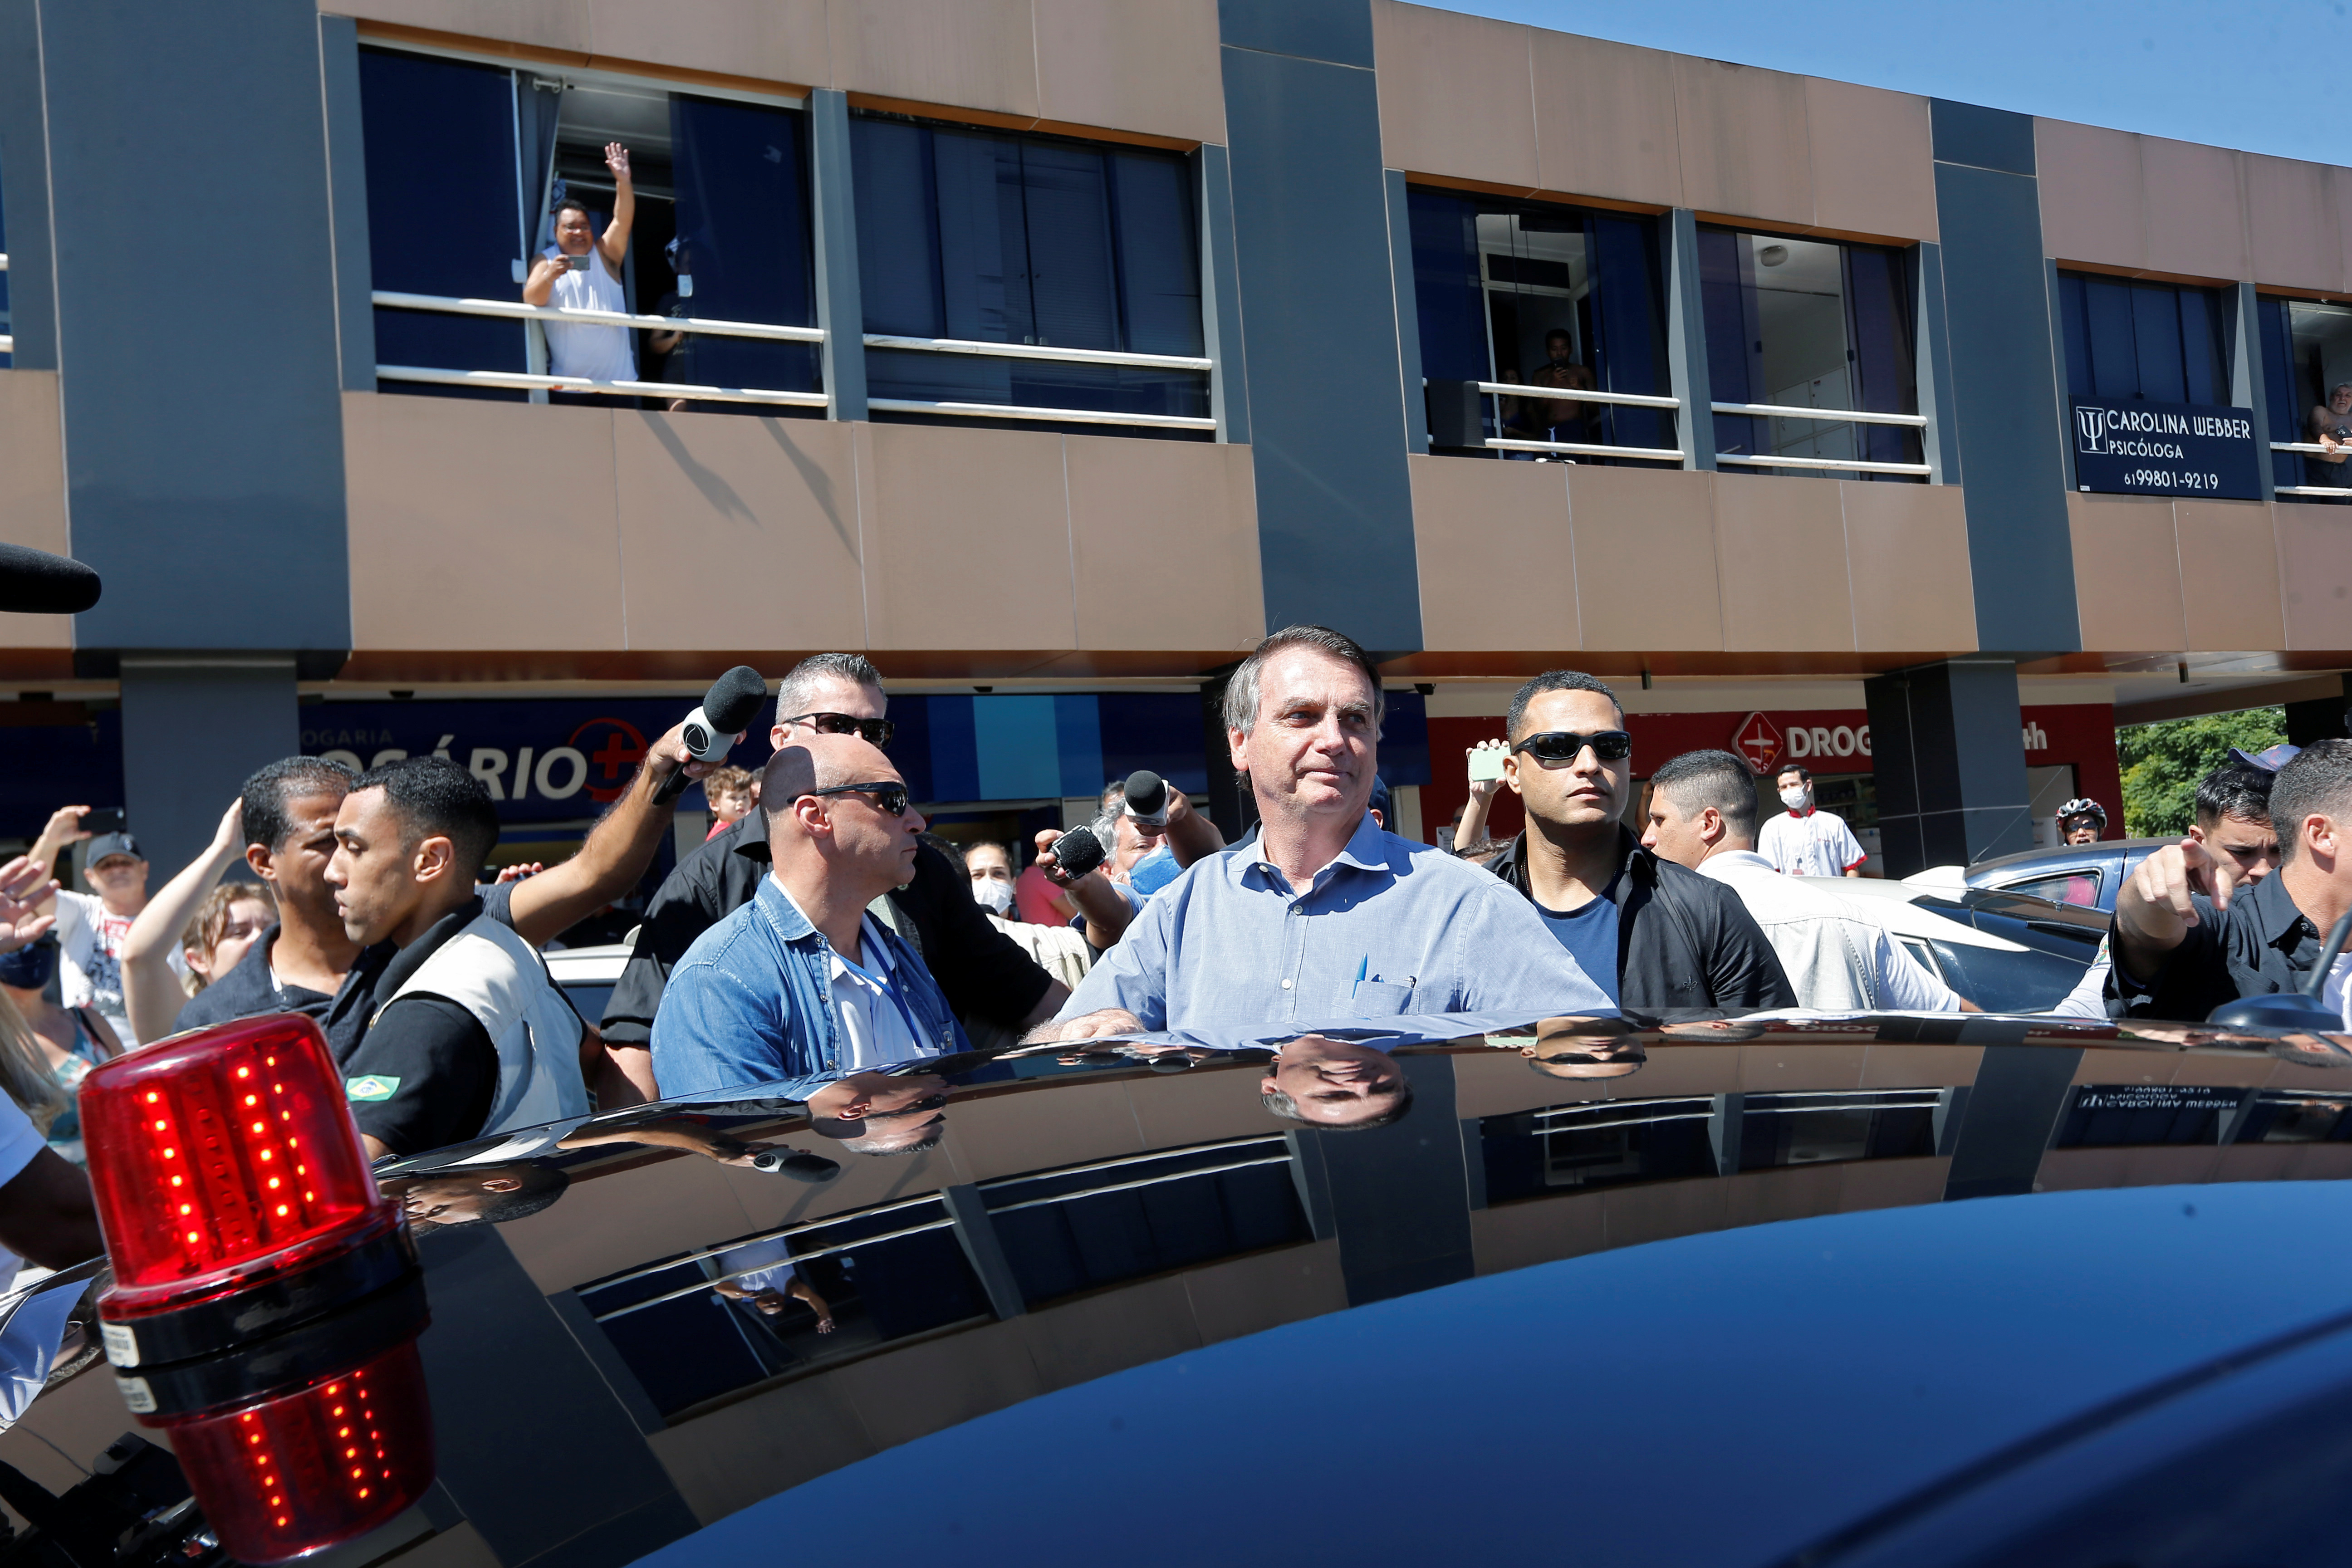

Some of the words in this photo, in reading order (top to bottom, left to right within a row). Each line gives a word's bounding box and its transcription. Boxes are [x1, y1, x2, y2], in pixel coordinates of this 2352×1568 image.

[2107, 410, 2190, 435] CAROLINA
[2193, 416, 2250, 439] WEBBER
[2109, 437, 2184, 459] PSICÓLOGA
[1786, 725, 1872, 758] DROG
